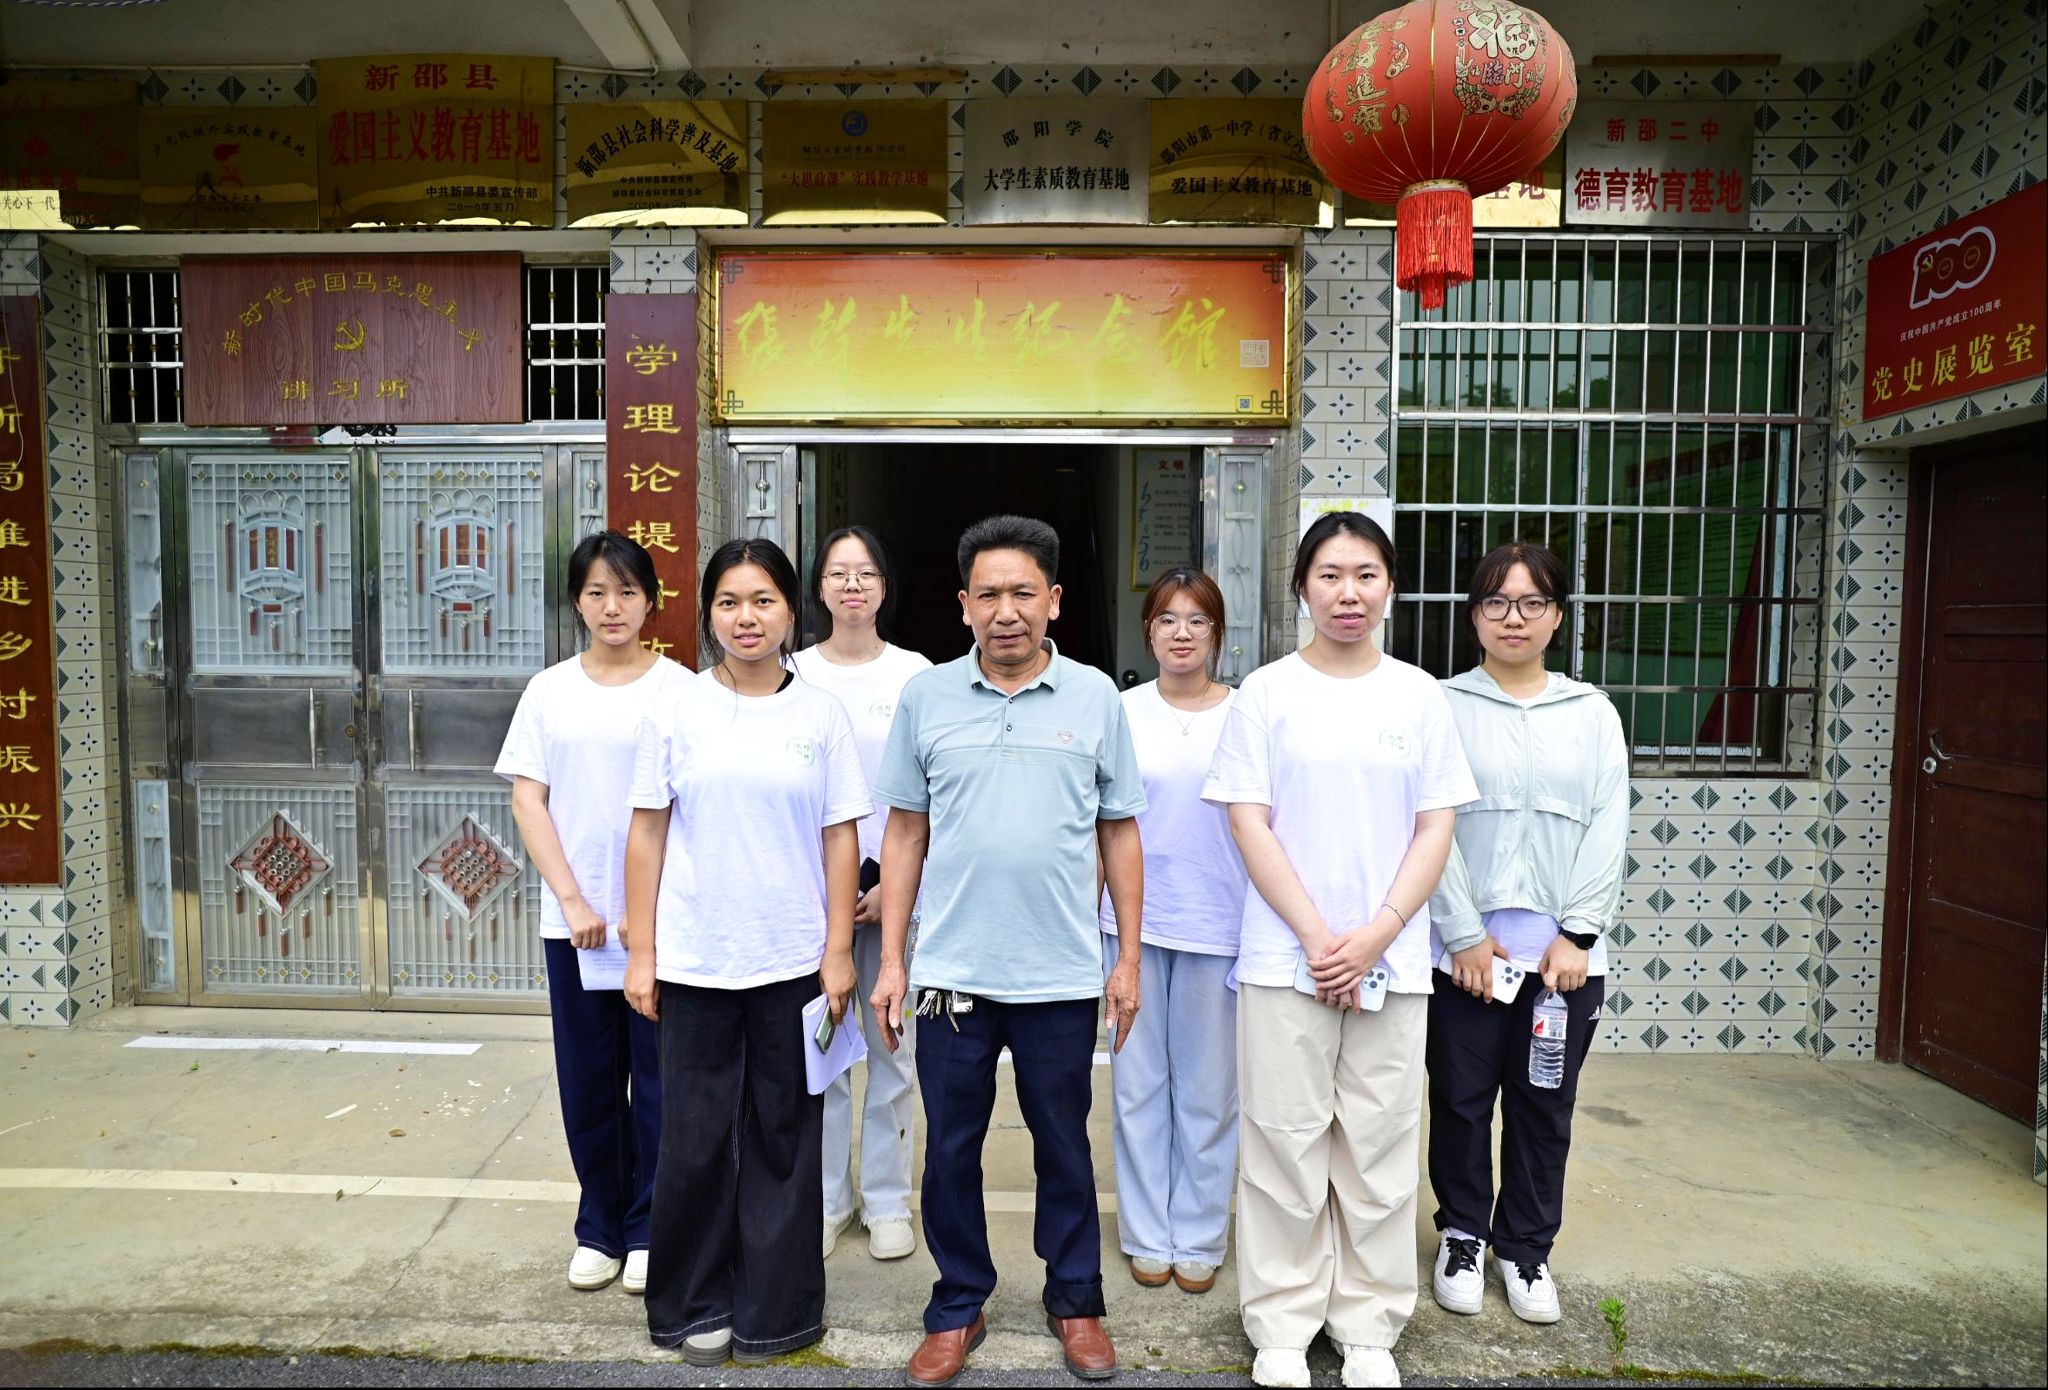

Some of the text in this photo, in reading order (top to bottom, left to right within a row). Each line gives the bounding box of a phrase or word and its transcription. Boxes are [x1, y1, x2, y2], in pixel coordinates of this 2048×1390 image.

[364, 63, 498, 92] 新邵县
[329, 108, 542, 166] 爱国主义教育基地
[1003, 120, 1114, 149] 邵阳学院
[1606, 118, 1720, 143] 新邵二中
[574, 116, 739, 179] 新邵县社会科学普及基地
[426, 186, 538, 200] 中共新邵县委宣传部
[983, 167, 1130, 192] 大学生素质教育基地
[1171, 177, 1313, 197] 爱国主义教育基地
[1575, 166, 1744, 214] 德育教育基地
[1900, 299, 2001, 342] 庆祝中国共产党成立100周年
[1872, 322, 2036, 404] 党史展览室
[280, 379, 409, 401] 讲习所
